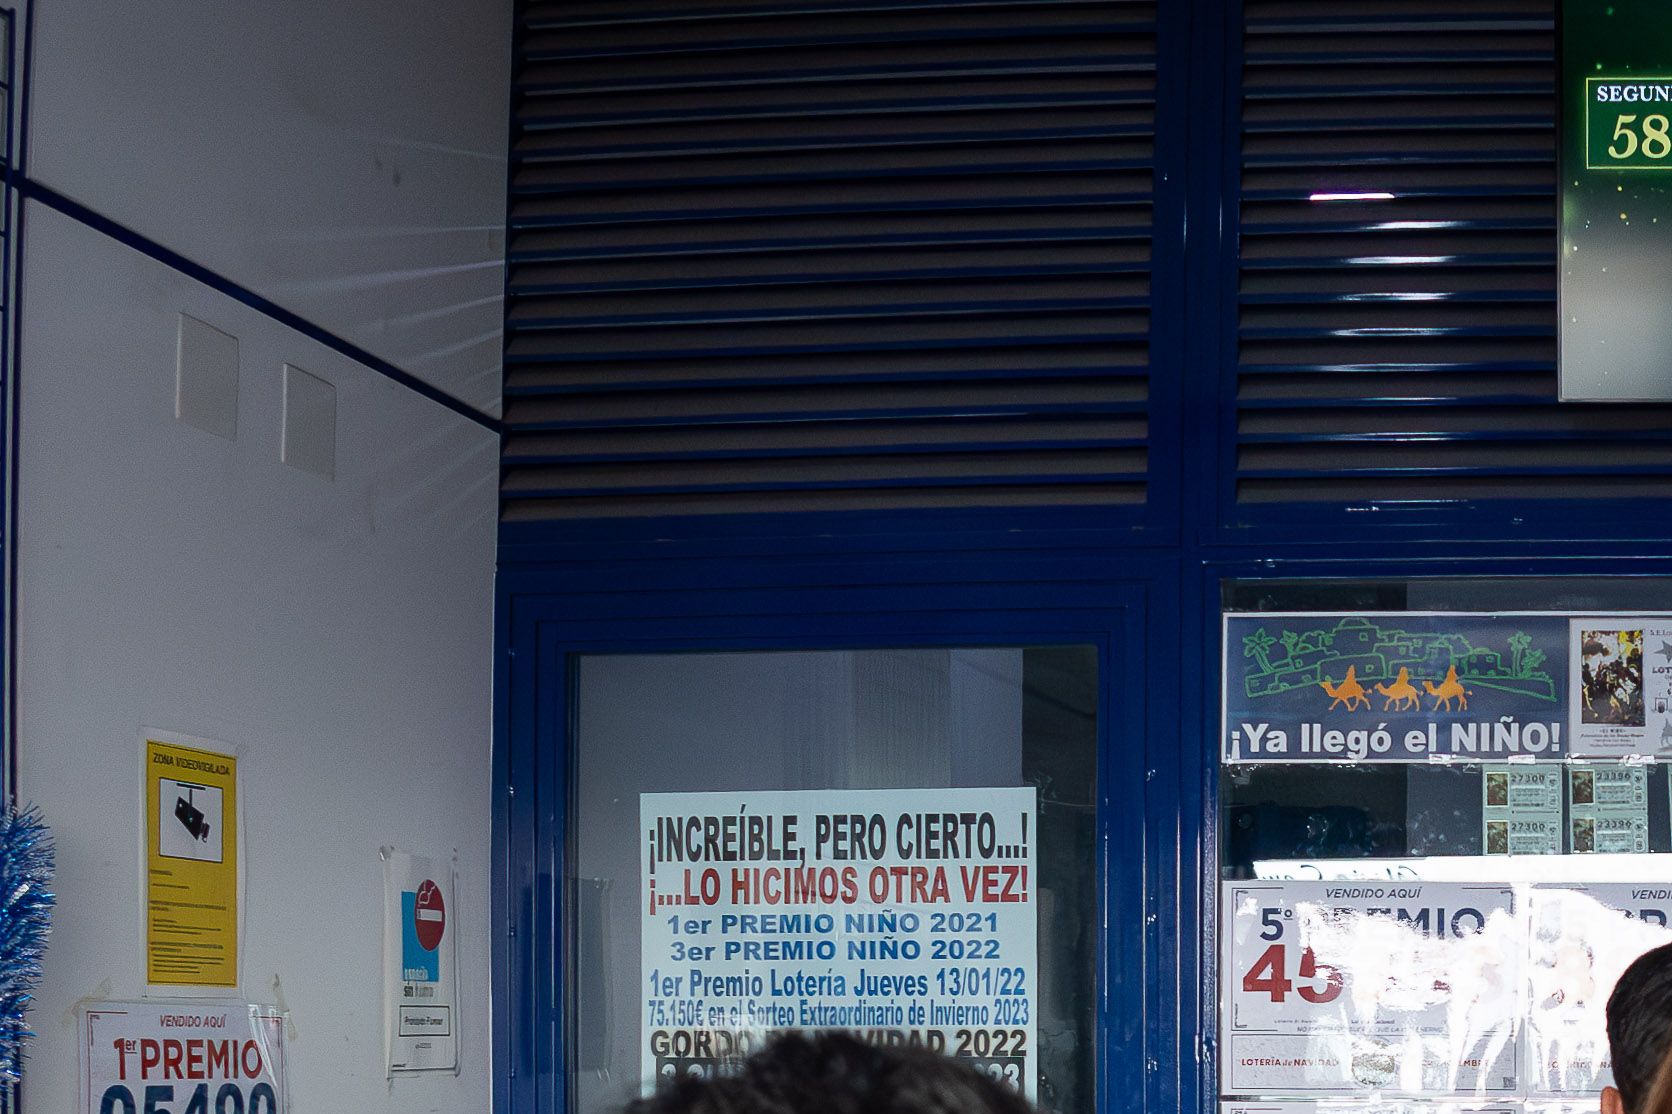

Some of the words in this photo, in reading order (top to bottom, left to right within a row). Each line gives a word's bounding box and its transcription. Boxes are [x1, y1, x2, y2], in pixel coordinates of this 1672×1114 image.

[1230, 722, 1288, 760] ¡Ya
[1300, 720, 1390, 760] llegó
[1403, 720, 1437, 753] el
[1451, 715, 1560, 754] NIÑO!
[648, 803, 806, 875] ¡INCREÍBLE,
[815, 813, 887, 861] PERO
[896, 811, 1029, 860] CIERTO...!
[731, 866, 859, 905] HICIMOS
[869, 865, 950, 904] OTRA
[960, 864, 1029, 903] VEZ!
[1325, 888, 1384, 899] VENDIDO
[1386, 886, 1423, 899] AQUÍ
[667, 914, 712, 935] 1er
[721, 913, 835, 934] PREMIO
[845, 908, 920, 934] NIÑO
[930, 912, 999, 933] 2021
[670, 942, 716, 962] 3er
[724, 940, 836, 961] PREMIO
[847, 936, 922, 961] NIÑO
[931, 939, 1001, 960] 2022
[650, 969, 683, 998] 1er
[690, 968, 764, 998] Premio
[770, 966, 847, 998] Lotería
[853, 967, 928, 997] Jueves
[936, 966, 1027, 997] 13/01/22
[160, 1014, 200, 1027] VENDIDO
[202, 1013, 227, 1029] AQUÍ
[648, 1000, 704, 1027] 75.150€
[708, 1006, 726, 1026] en
[728, 1001, 744, 1026] el
[747, 1000, 795, 1027] Sorteo
[800, 999, 904, 1027] Extraordinario
[908, 999, 926, 1026] de
[930, 999, 989, 1026] Invierno
[993, 999, 1030, 1026] 2023
[651, 1030, 750, 1058] GORDO
[956, 1029, 1028, 1057] 2022
[113, 1037, 137, 1081] 1er
[141, 1039, 263, 1081] PREMIO
[1241, 1057, 1281, 1067] LOTERÍA
